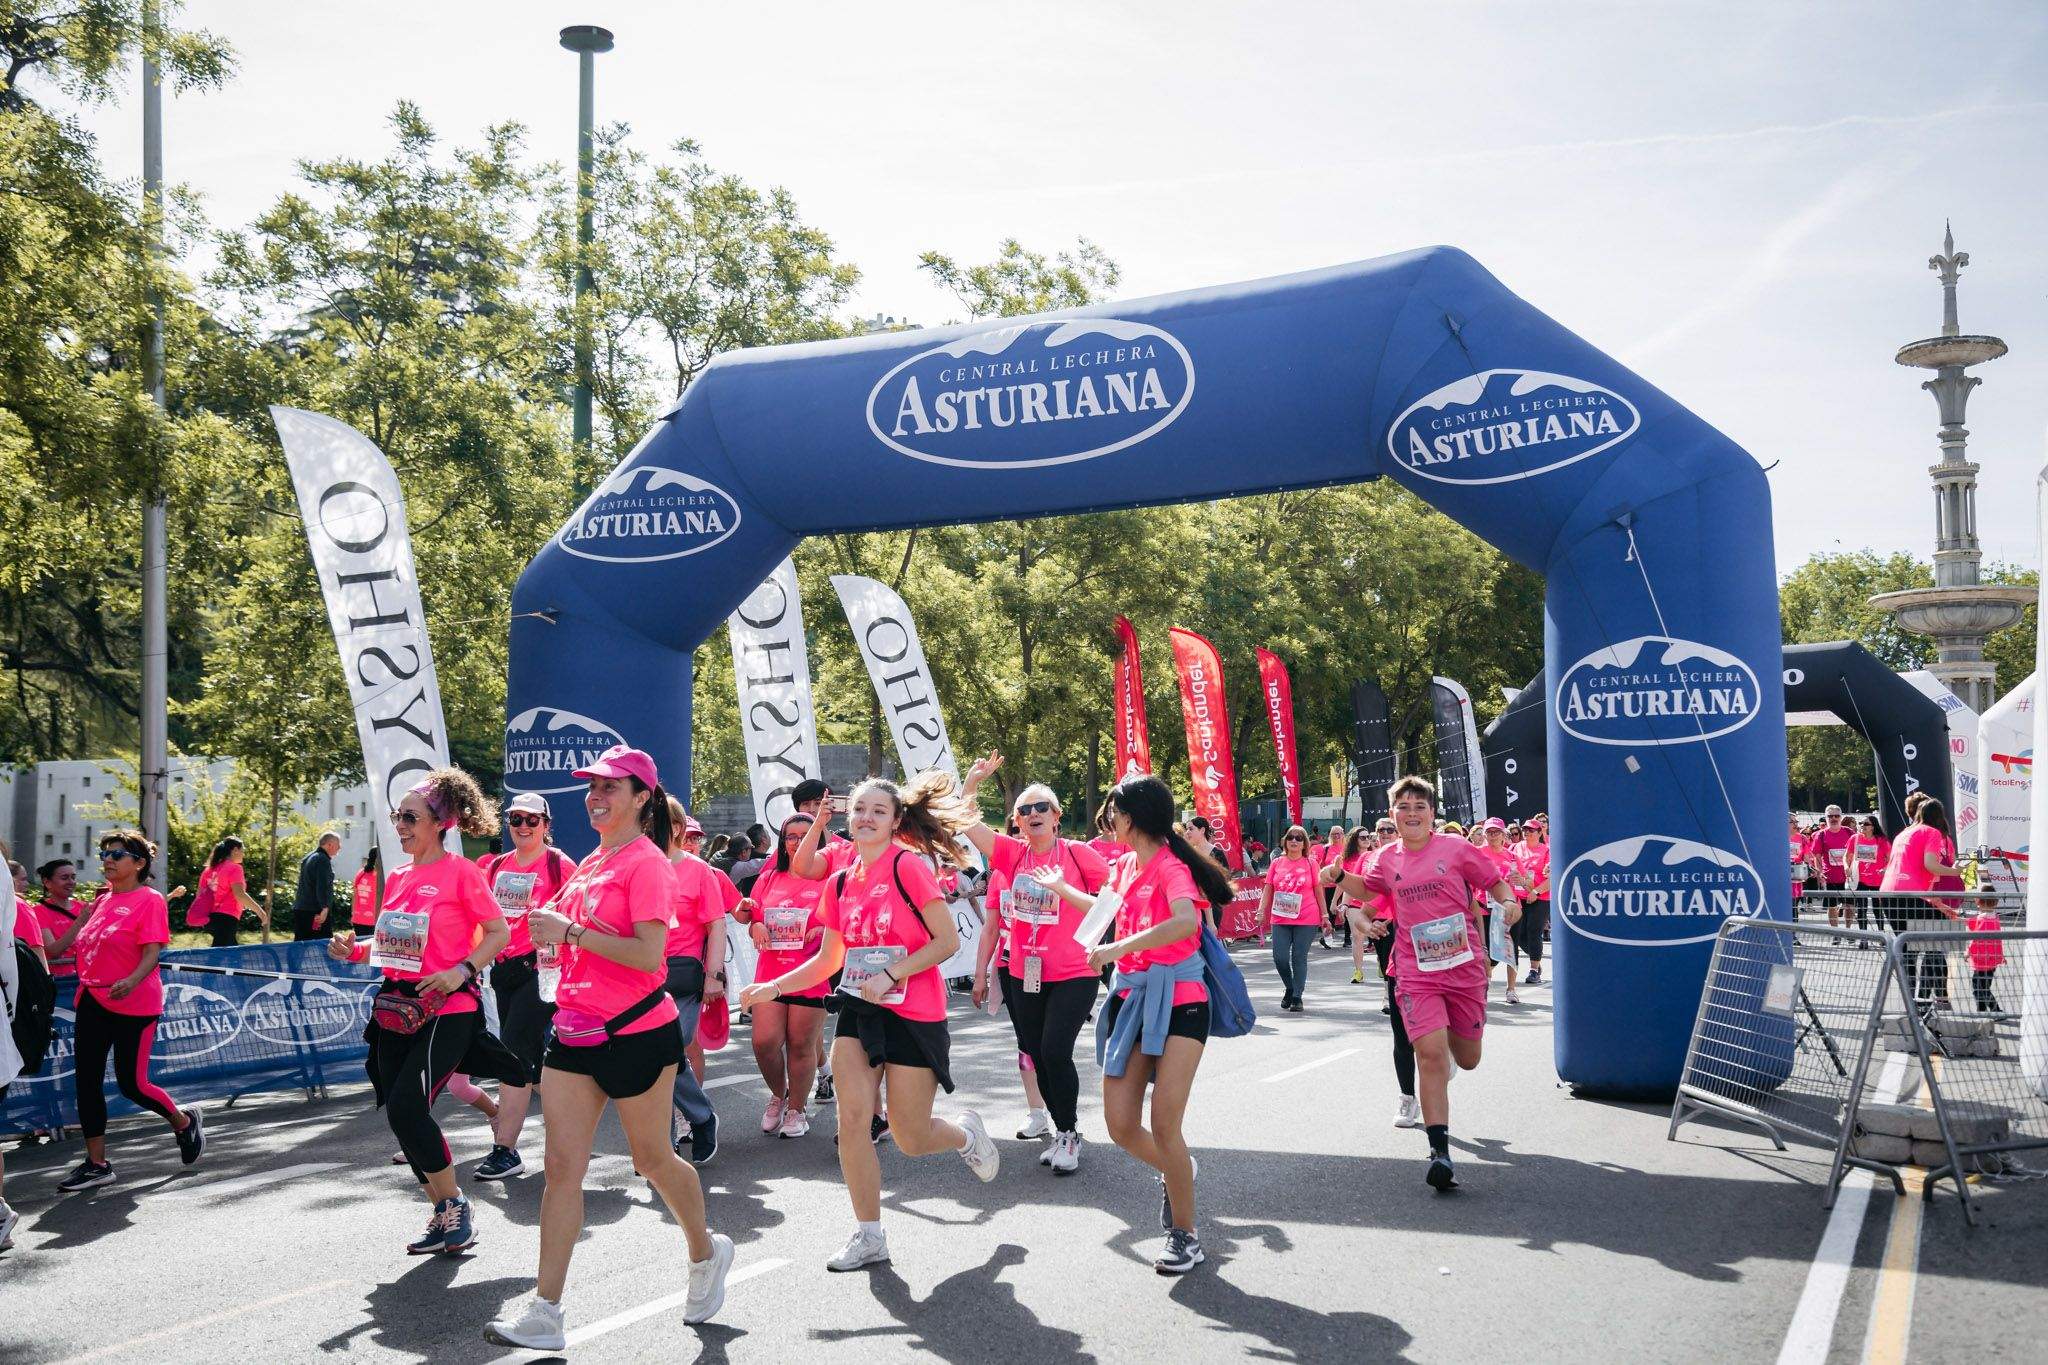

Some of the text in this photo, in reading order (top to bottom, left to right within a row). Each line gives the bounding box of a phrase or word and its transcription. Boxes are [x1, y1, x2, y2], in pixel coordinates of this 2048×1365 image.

[940, 344, 1158, 383] CENTRAL LECHERA
[892, 367, 1171, 437] ASTURIANA
[1431, 396, 1609, 431] CENTRAL LECHERA
[1408, 409, 1622, 467] ASTURIANA
[594, 496, 715, 512] CENTRAL LECHERA
[565, 509, 726, 541] ASTURIANA
[1589, 673, 1741, 688] CENTRAL LECHERA
[1565, 681, 1749, 723] ASTURIANA
[509, 736, 611, 747] CENTRAL LECHERA
[507, 749, 600, 774] STURIAN
[1591, 871, 1744, 885] CENTRAL LECHERA
[1566, 878, 1752, 917] ASTURIANA
[156, 1014, 234, 1041] TURIANA
[254, 1002, 348, 1030] ASTURIANA
